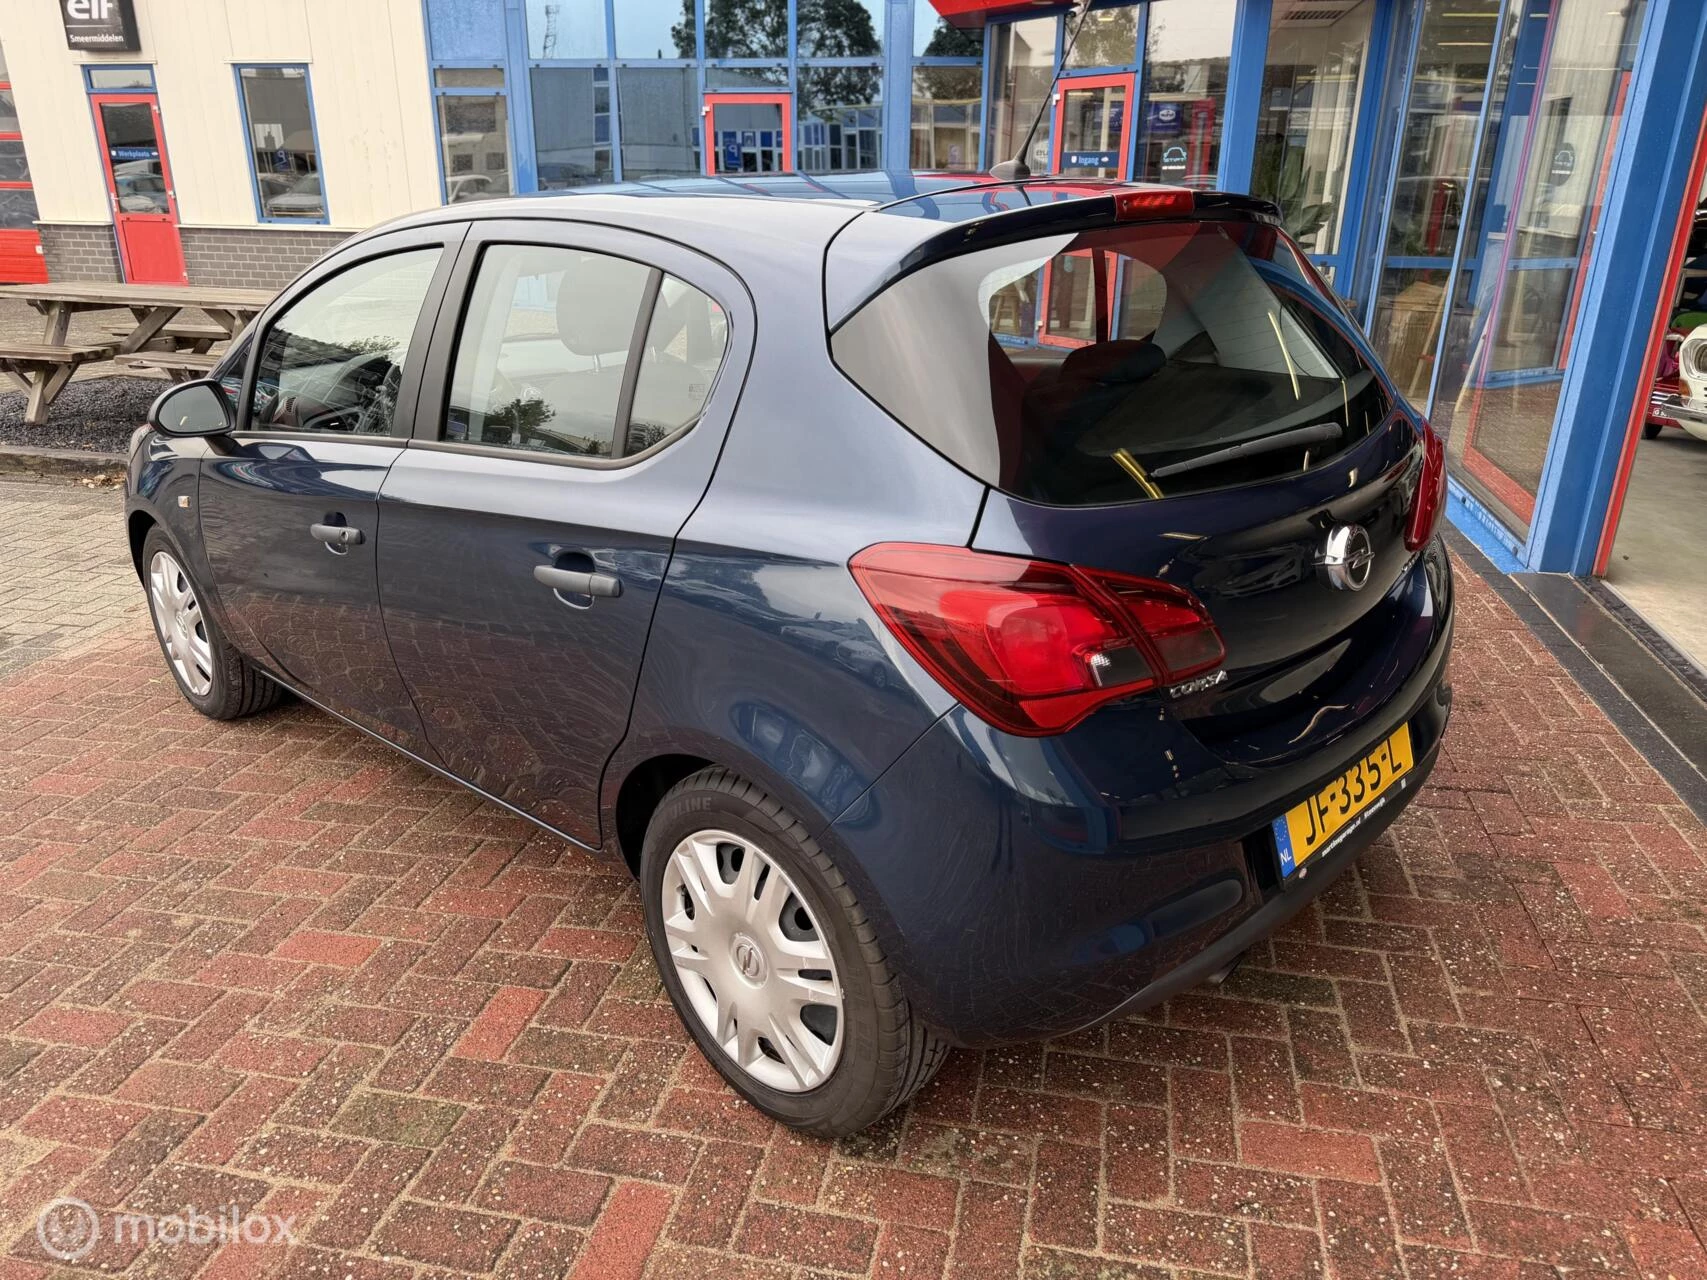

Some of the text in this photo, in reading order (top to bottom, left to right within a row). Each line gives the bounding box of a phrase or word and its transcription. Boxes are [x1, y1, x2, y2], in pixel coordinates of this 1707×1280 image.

[67, 0, 113, 19] elf
[69, 33, 125, 43] Smeermiddelen
[1078, 155, 1099, 166] Ingang
[1305, 738, 1402, 846] JF-335-L
[1279, 847, 1293, 866] NL
